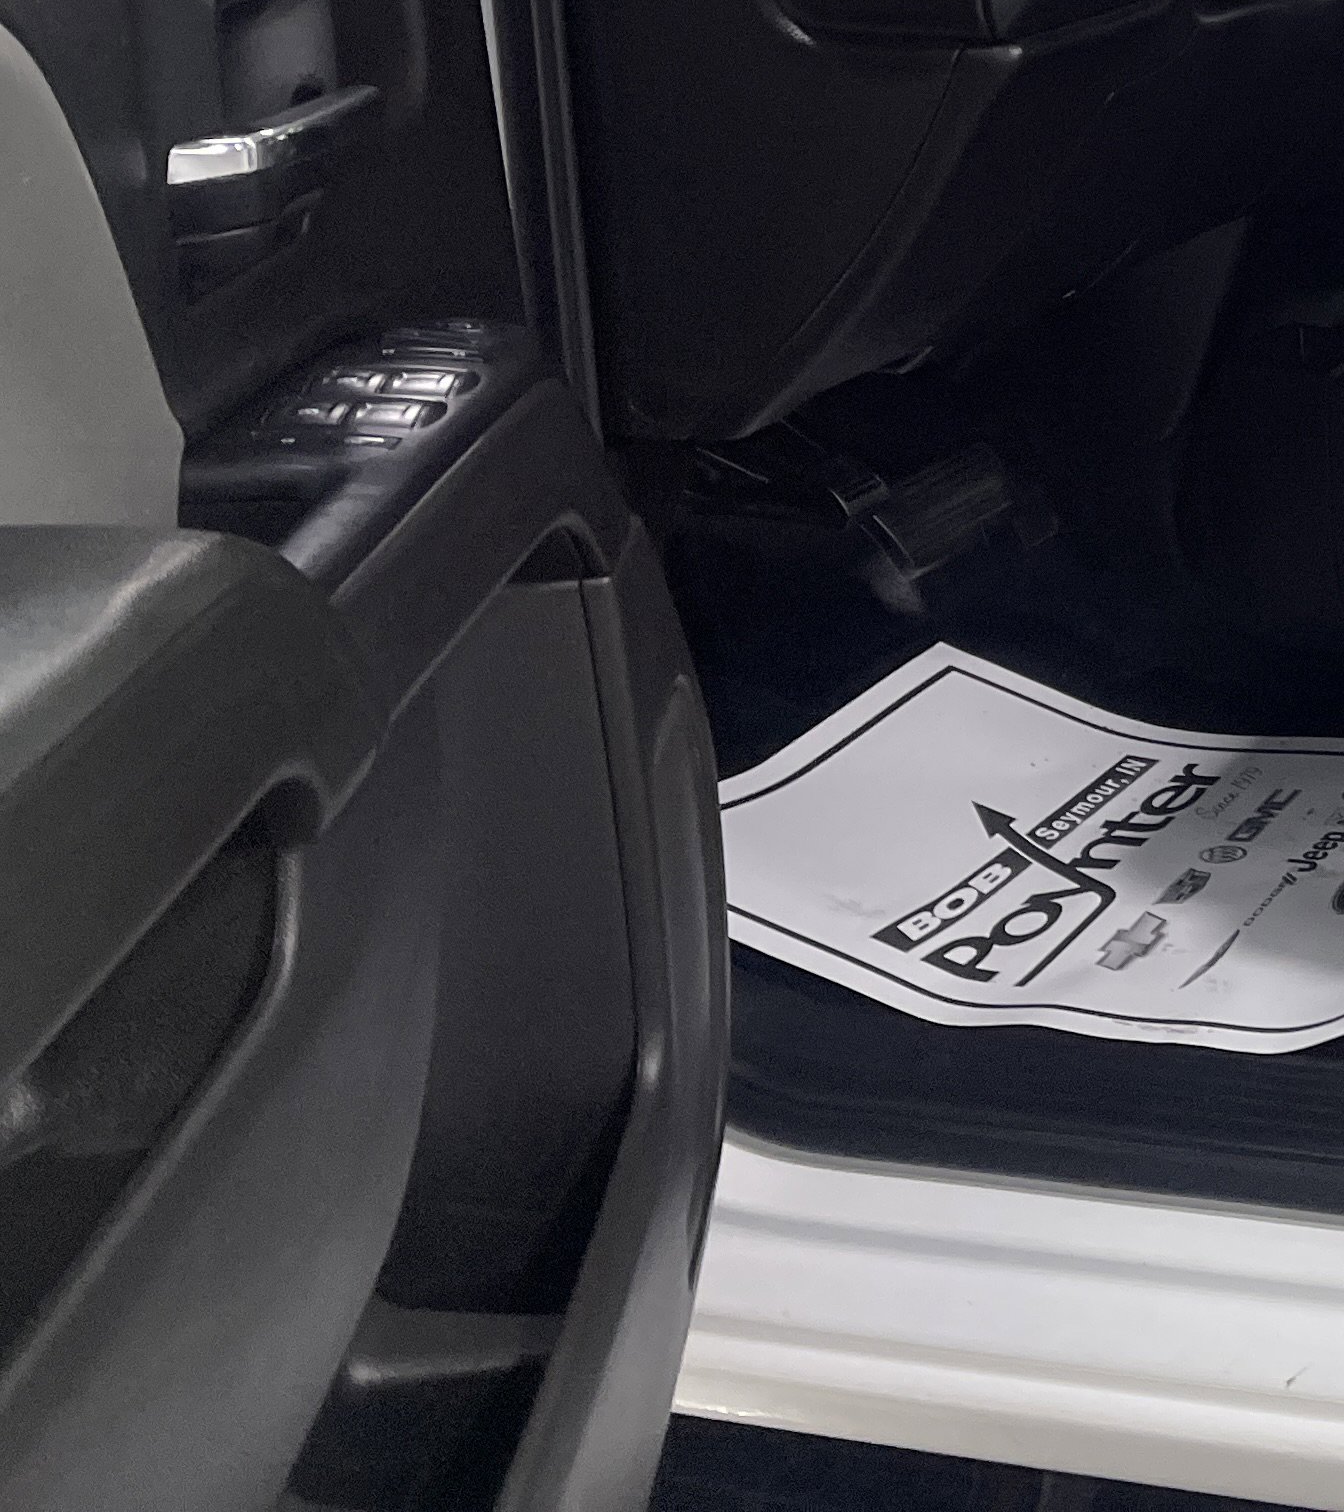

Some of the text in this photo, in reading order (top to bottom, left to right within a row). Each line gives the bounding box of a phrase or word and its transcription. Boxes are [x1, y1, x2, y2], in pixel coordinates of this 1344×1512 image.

[1035, 758, 1147, 840] Seymour, IN
[1226, 788, 1302, 842] GMC
[896, 862, 1012, 942] BOB
